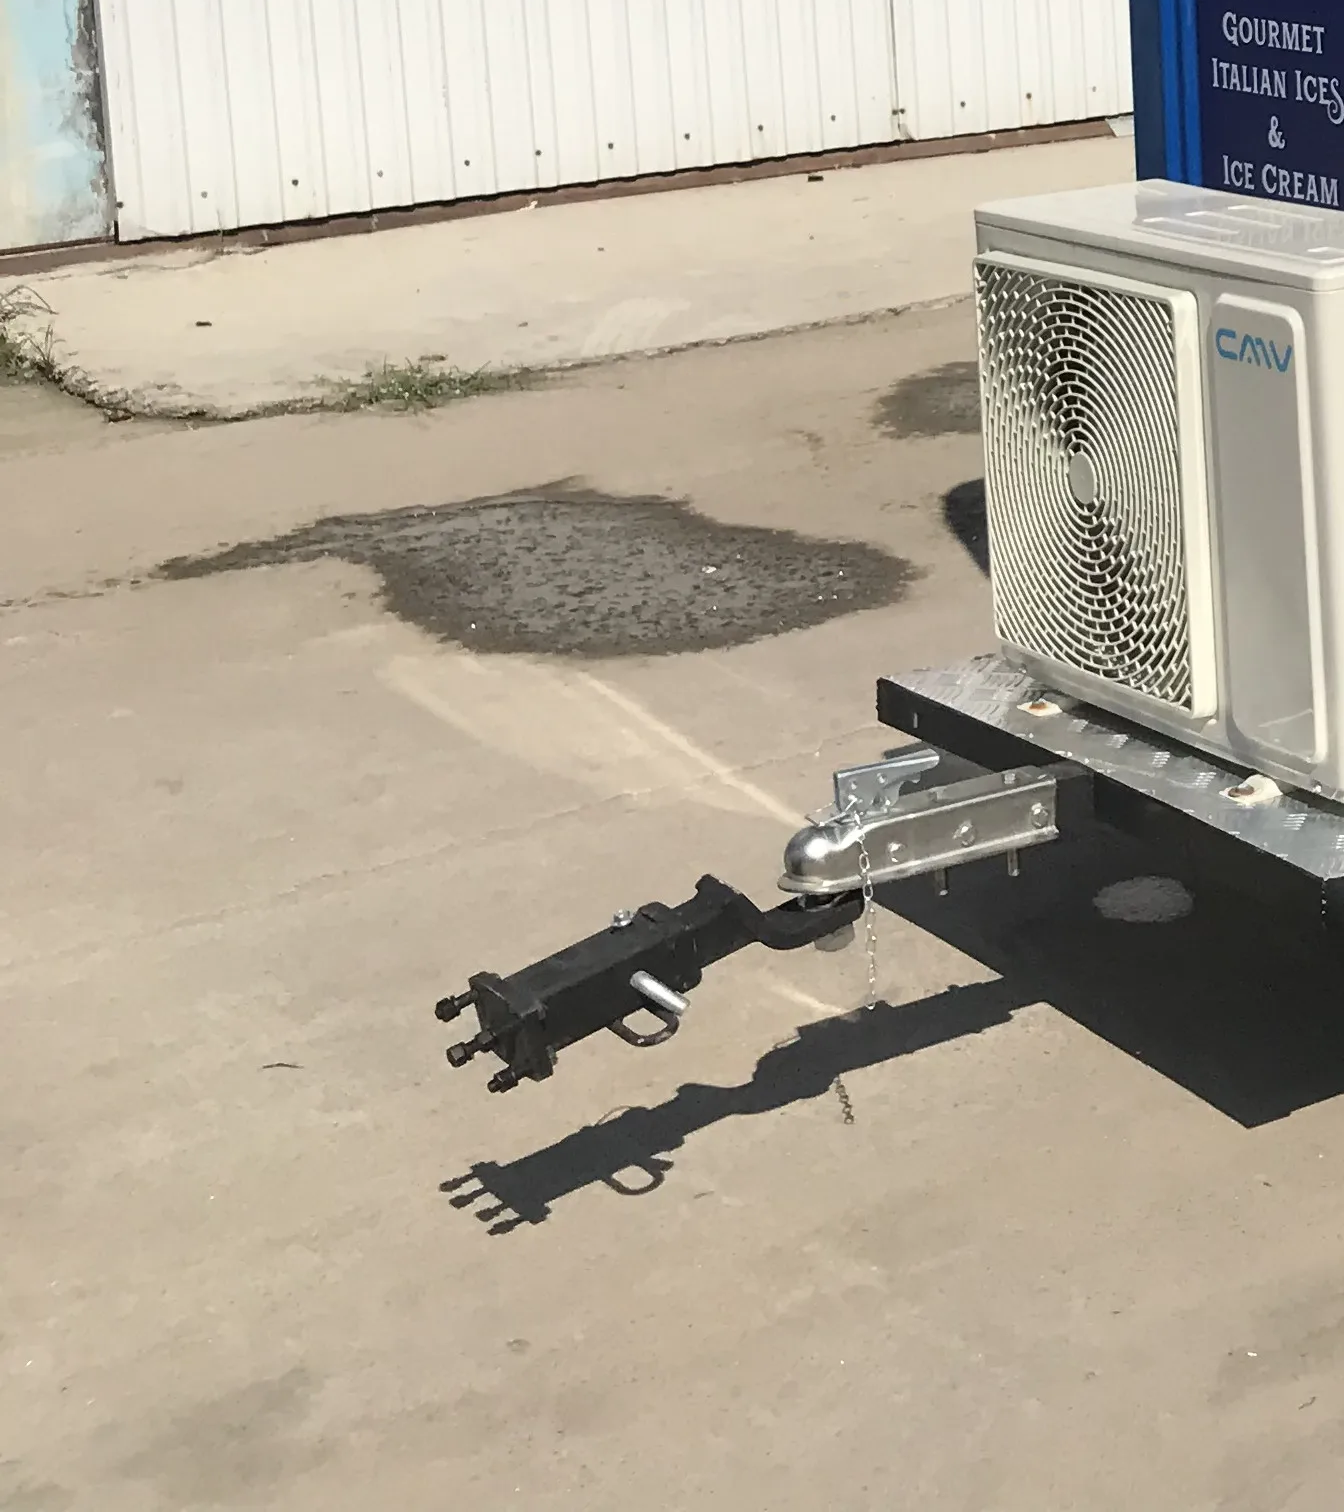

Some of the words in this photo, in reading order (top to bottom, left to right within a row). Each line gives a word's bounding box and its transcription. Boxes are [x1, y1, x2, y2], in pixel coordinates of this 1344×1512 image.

[1222, 10, 1326, 55] GOURMET
[1211, 57, 1287, 99] ITALIAN
[1267, 115, 1286, 150] &
[1222, 154, 1256, 190] ICE
[1261, 163, 1341, 207] CREAM
